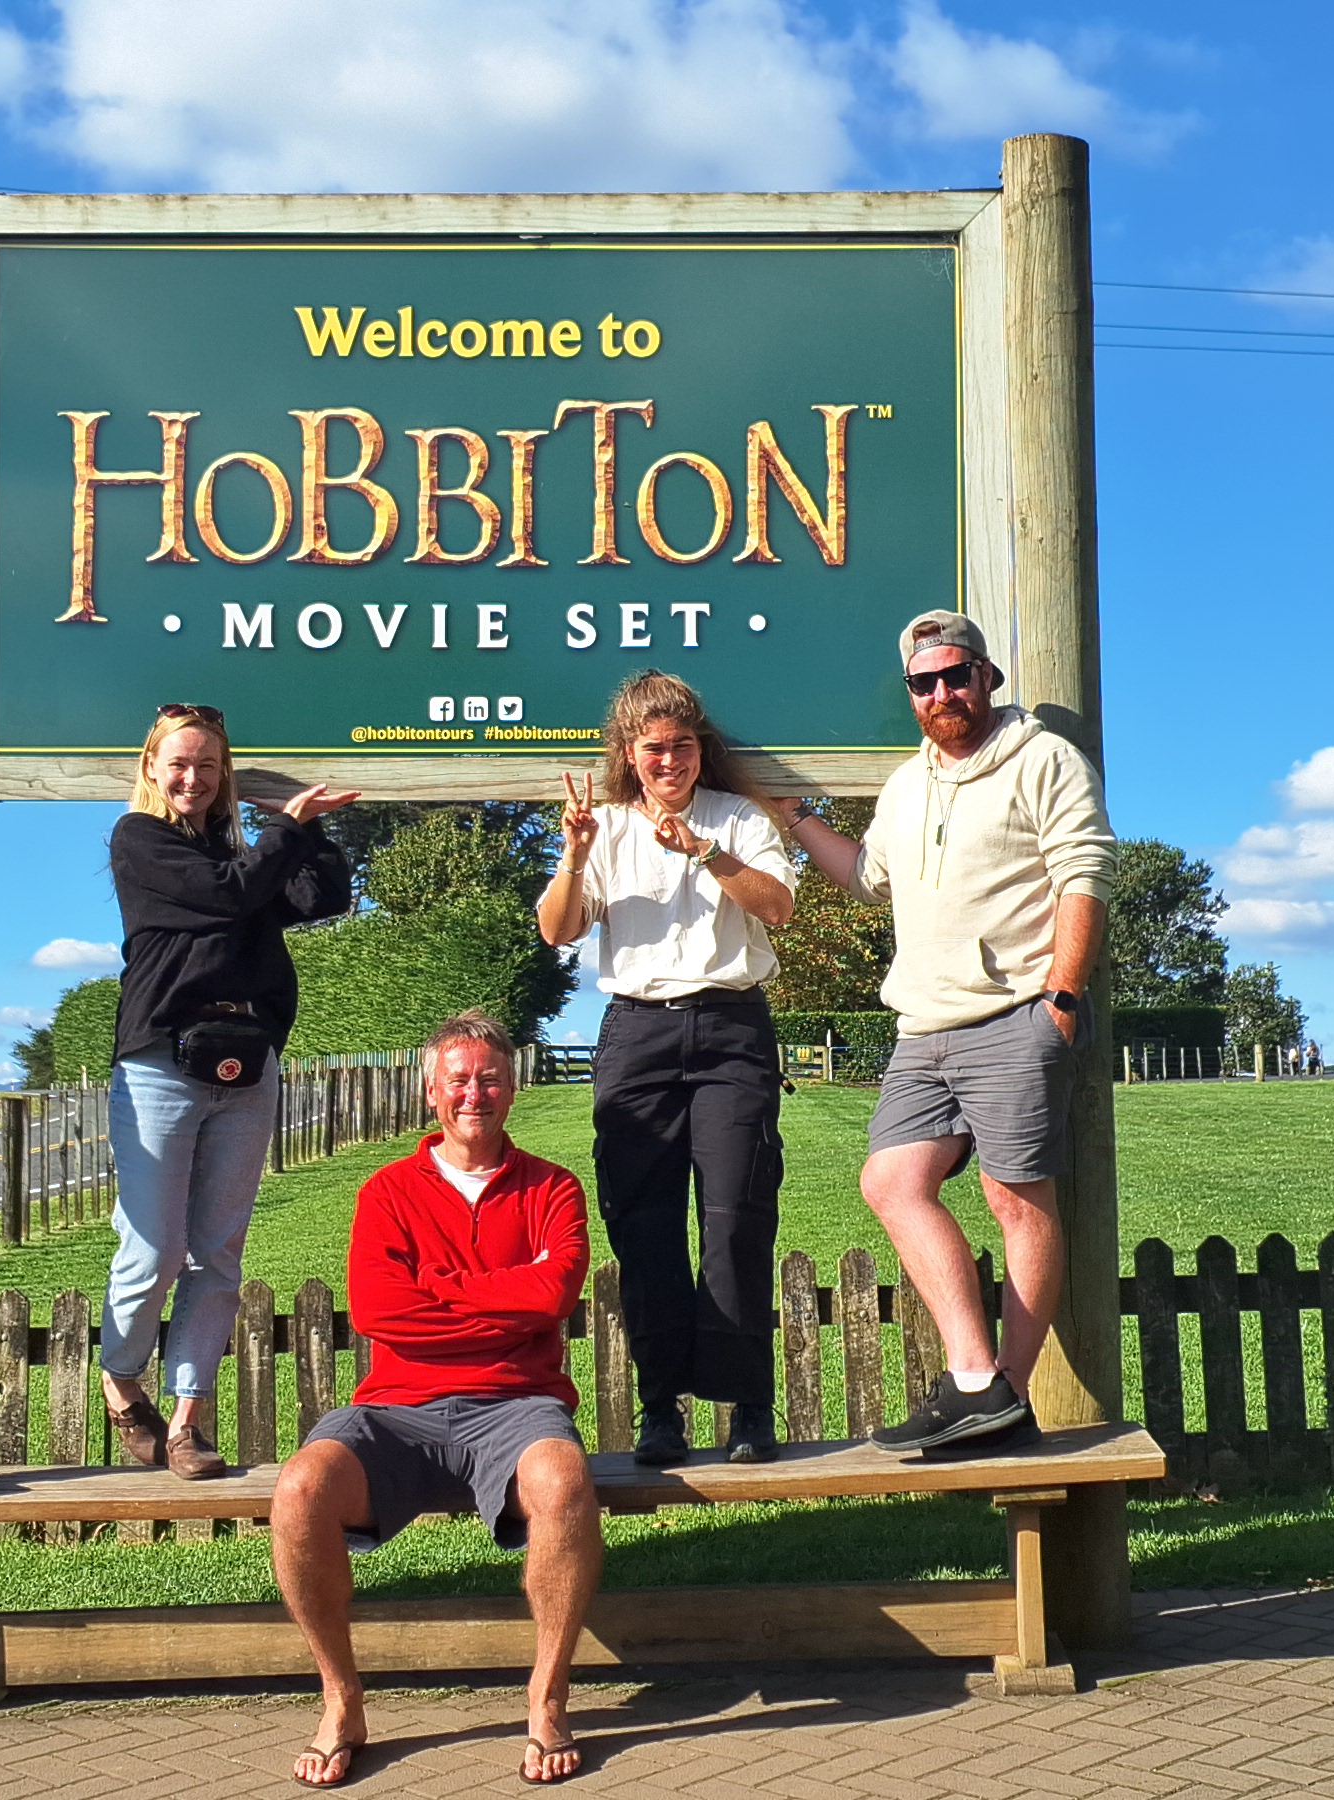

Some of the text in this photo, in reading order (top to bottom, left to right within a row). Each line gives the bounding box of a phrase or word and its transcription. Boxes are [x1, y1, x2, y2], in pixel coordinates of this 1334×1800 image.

[294, 305, 662, 358] Welcome to
[221, 602, 711, 649] MOVIE SET
[351, 726, 602, 743] @hobbitontours #hobbitontours
